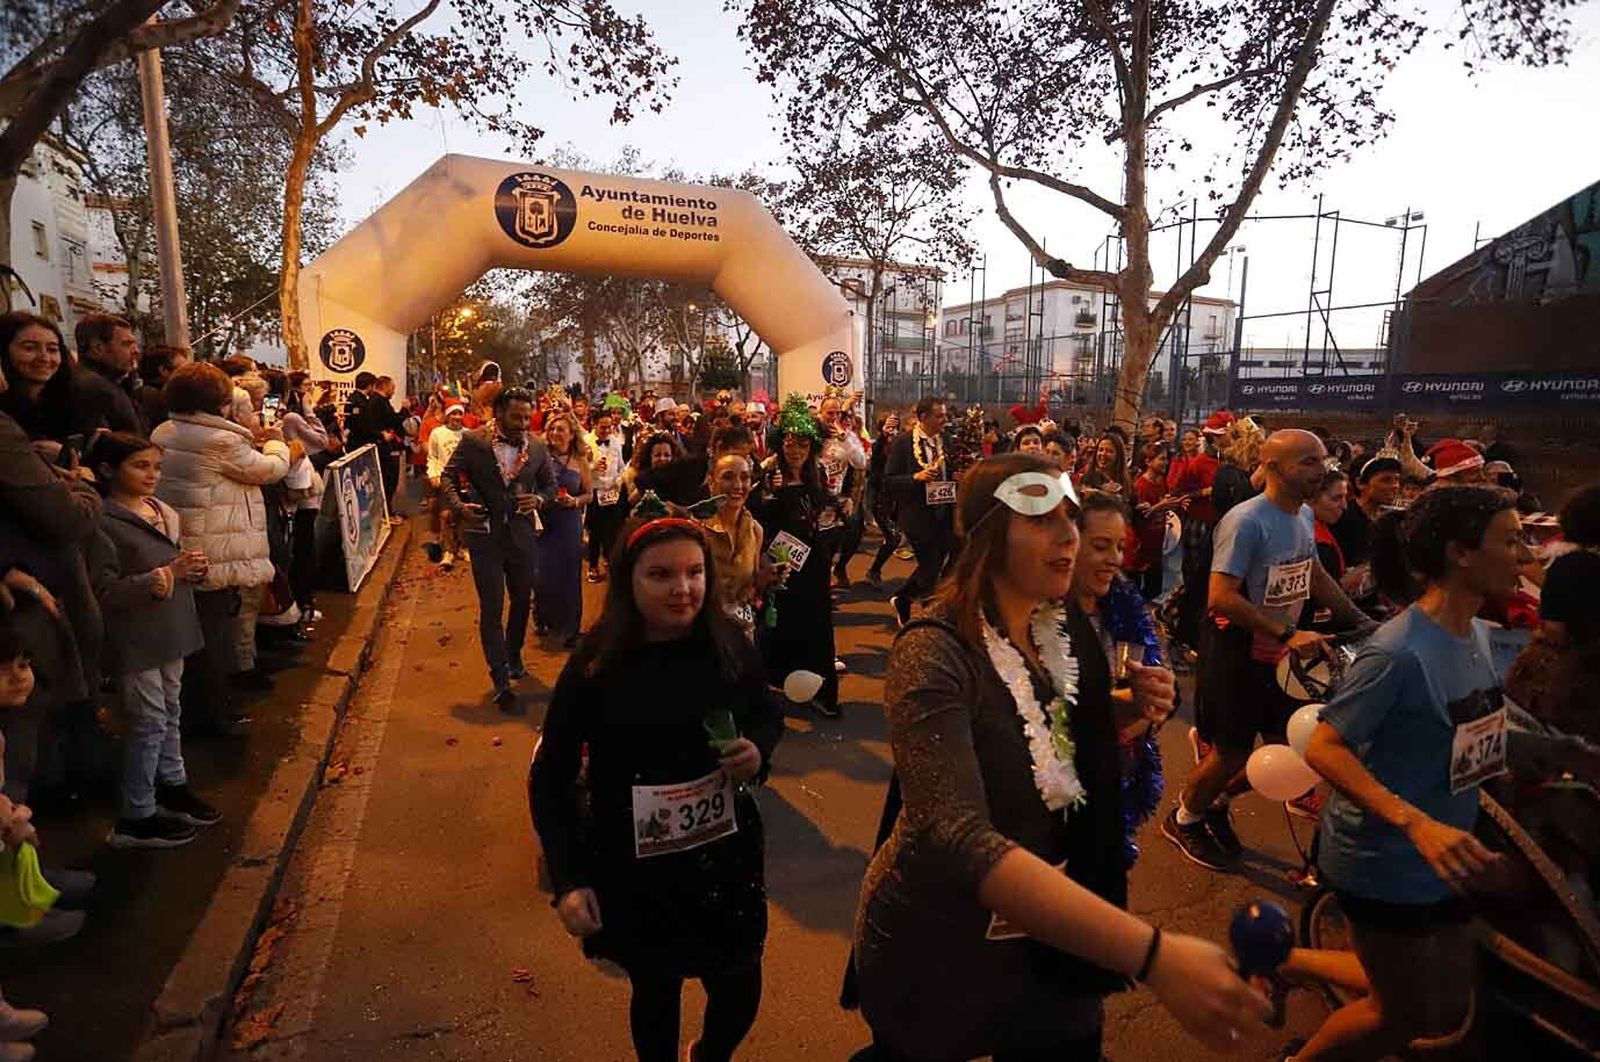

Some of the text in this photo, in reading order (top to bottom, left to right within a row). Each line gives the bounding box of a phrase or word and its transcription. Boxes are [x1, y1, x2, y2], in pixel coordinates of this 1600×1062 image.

[581, 185, 717, 211] Ayuntamiento
[621, 205, 717, 227] de Huelva
[652, 227, 667, 237] de
[670, 228, 720, 242] Deportes
[1257, 384, 1298, 394] HYUNDAI
[1327, 383, 1376, 393] HYUNDAI
[1424, 381, 1484, 391] HYUNDAI
[1529, 379, 1600, 391] HYUNDA
[1286, 573, 1306, 592] 373
[678, 792, 725, 831] 329
